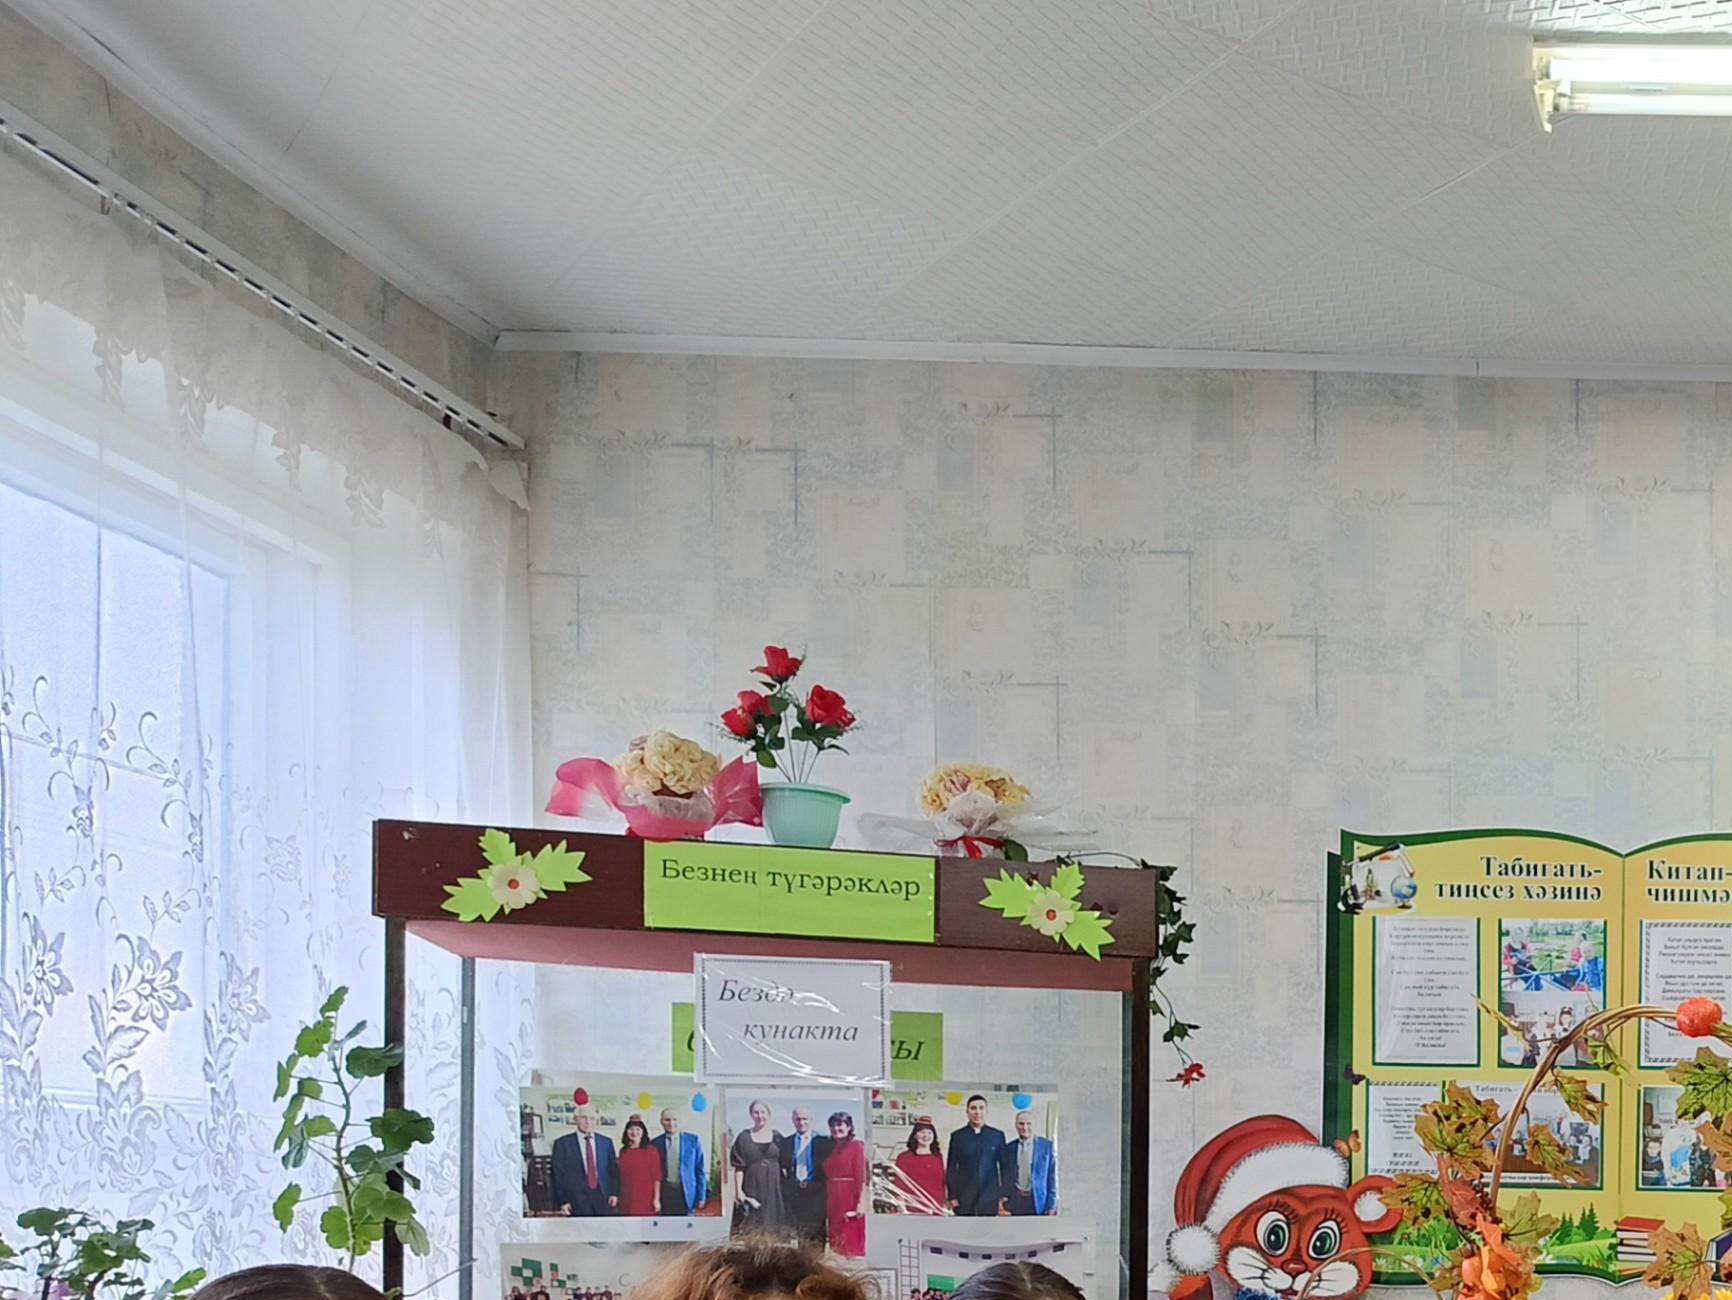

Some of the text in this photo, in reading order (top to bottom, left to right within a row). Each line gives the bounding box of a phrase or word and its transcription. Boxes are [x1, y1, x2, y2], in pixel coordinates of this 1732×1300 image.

[661, 858, 921, 901] Безнең түгәрәкләр
[1480, 856, 1602, 882] Табигать-
[1434, 881, 1602, 904] тиңсез хәзинә
[744, 1023, 858, 1043] кунакта
